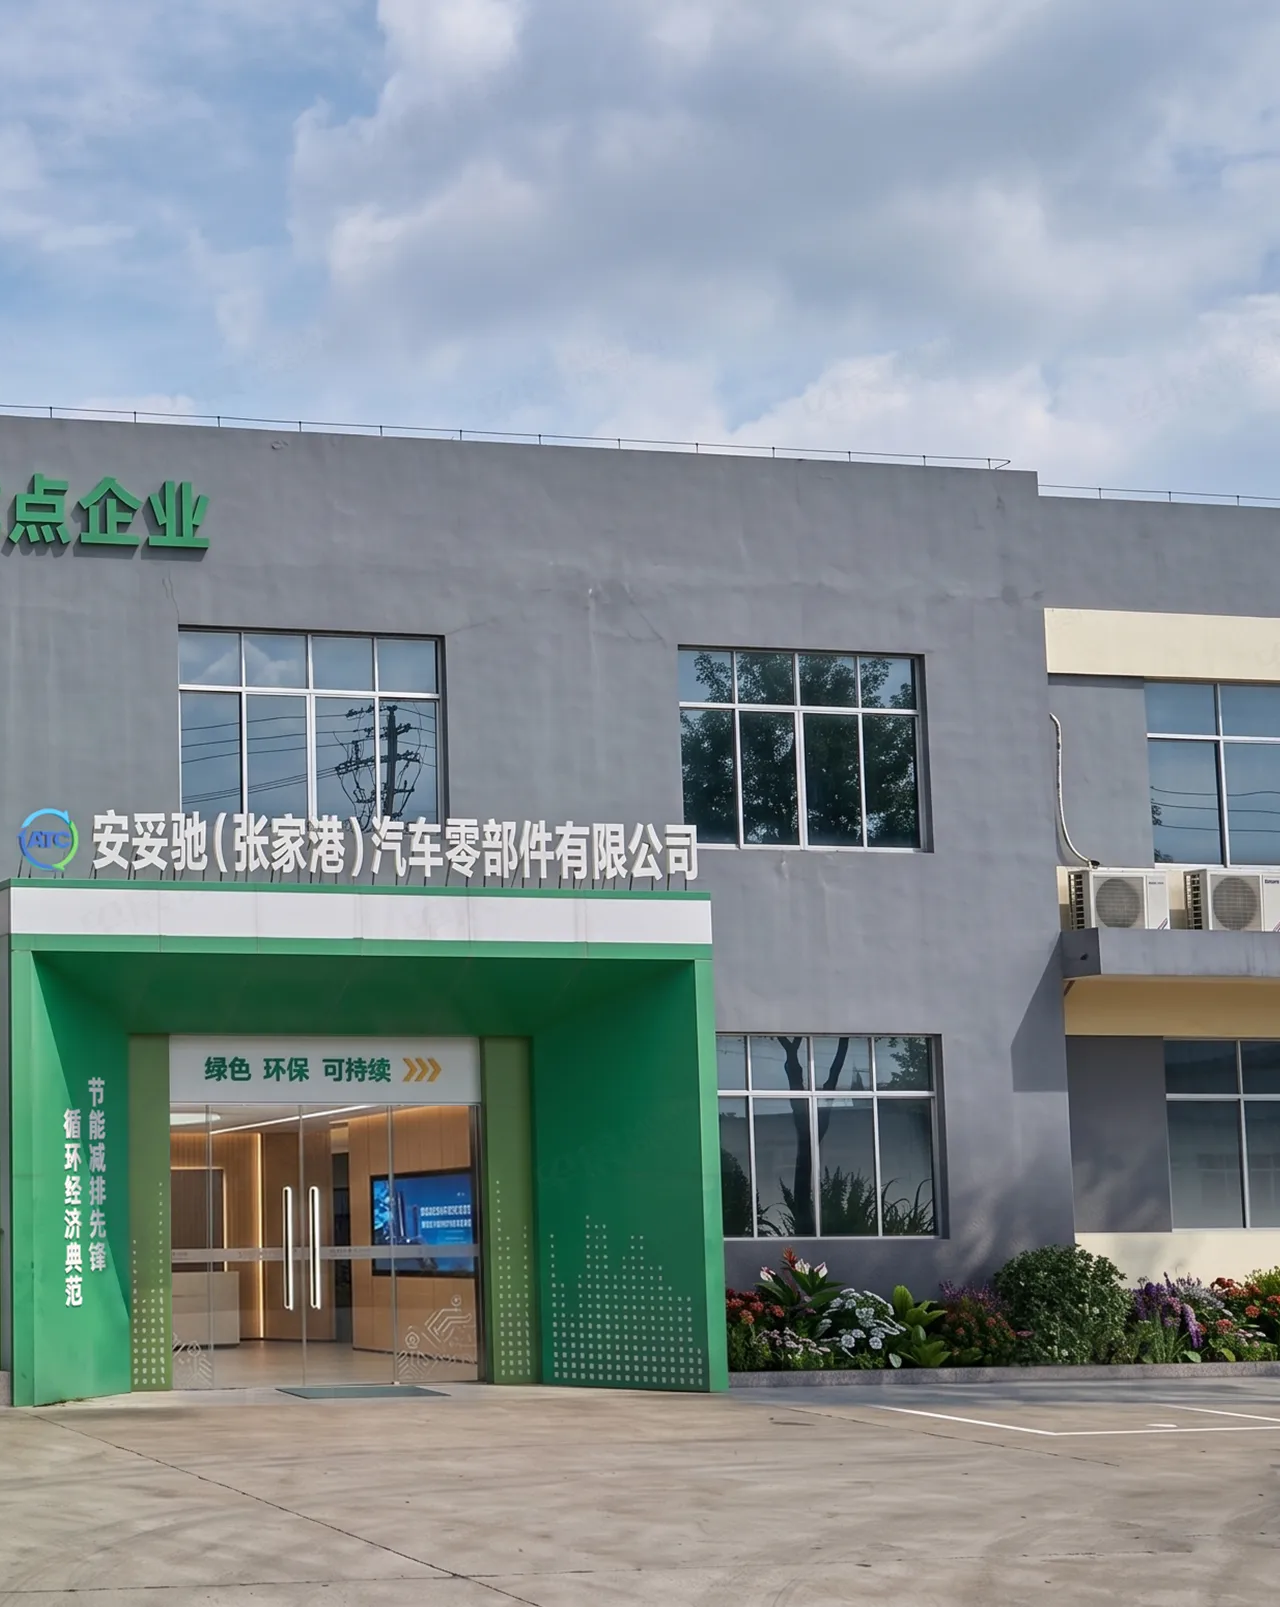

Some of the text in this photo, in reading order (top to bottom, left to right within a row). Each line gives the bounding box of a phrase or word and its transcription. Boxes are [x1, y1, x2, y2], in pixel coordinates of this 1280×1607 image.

[27, 831, 71, 849] ATC
[204, 1056, 391, 1083] 绿色 环保 可持续
[63, 1108, 83, 1307] 循环经济典范
[88, 1077, 107, 1272] 节能减排先锋
